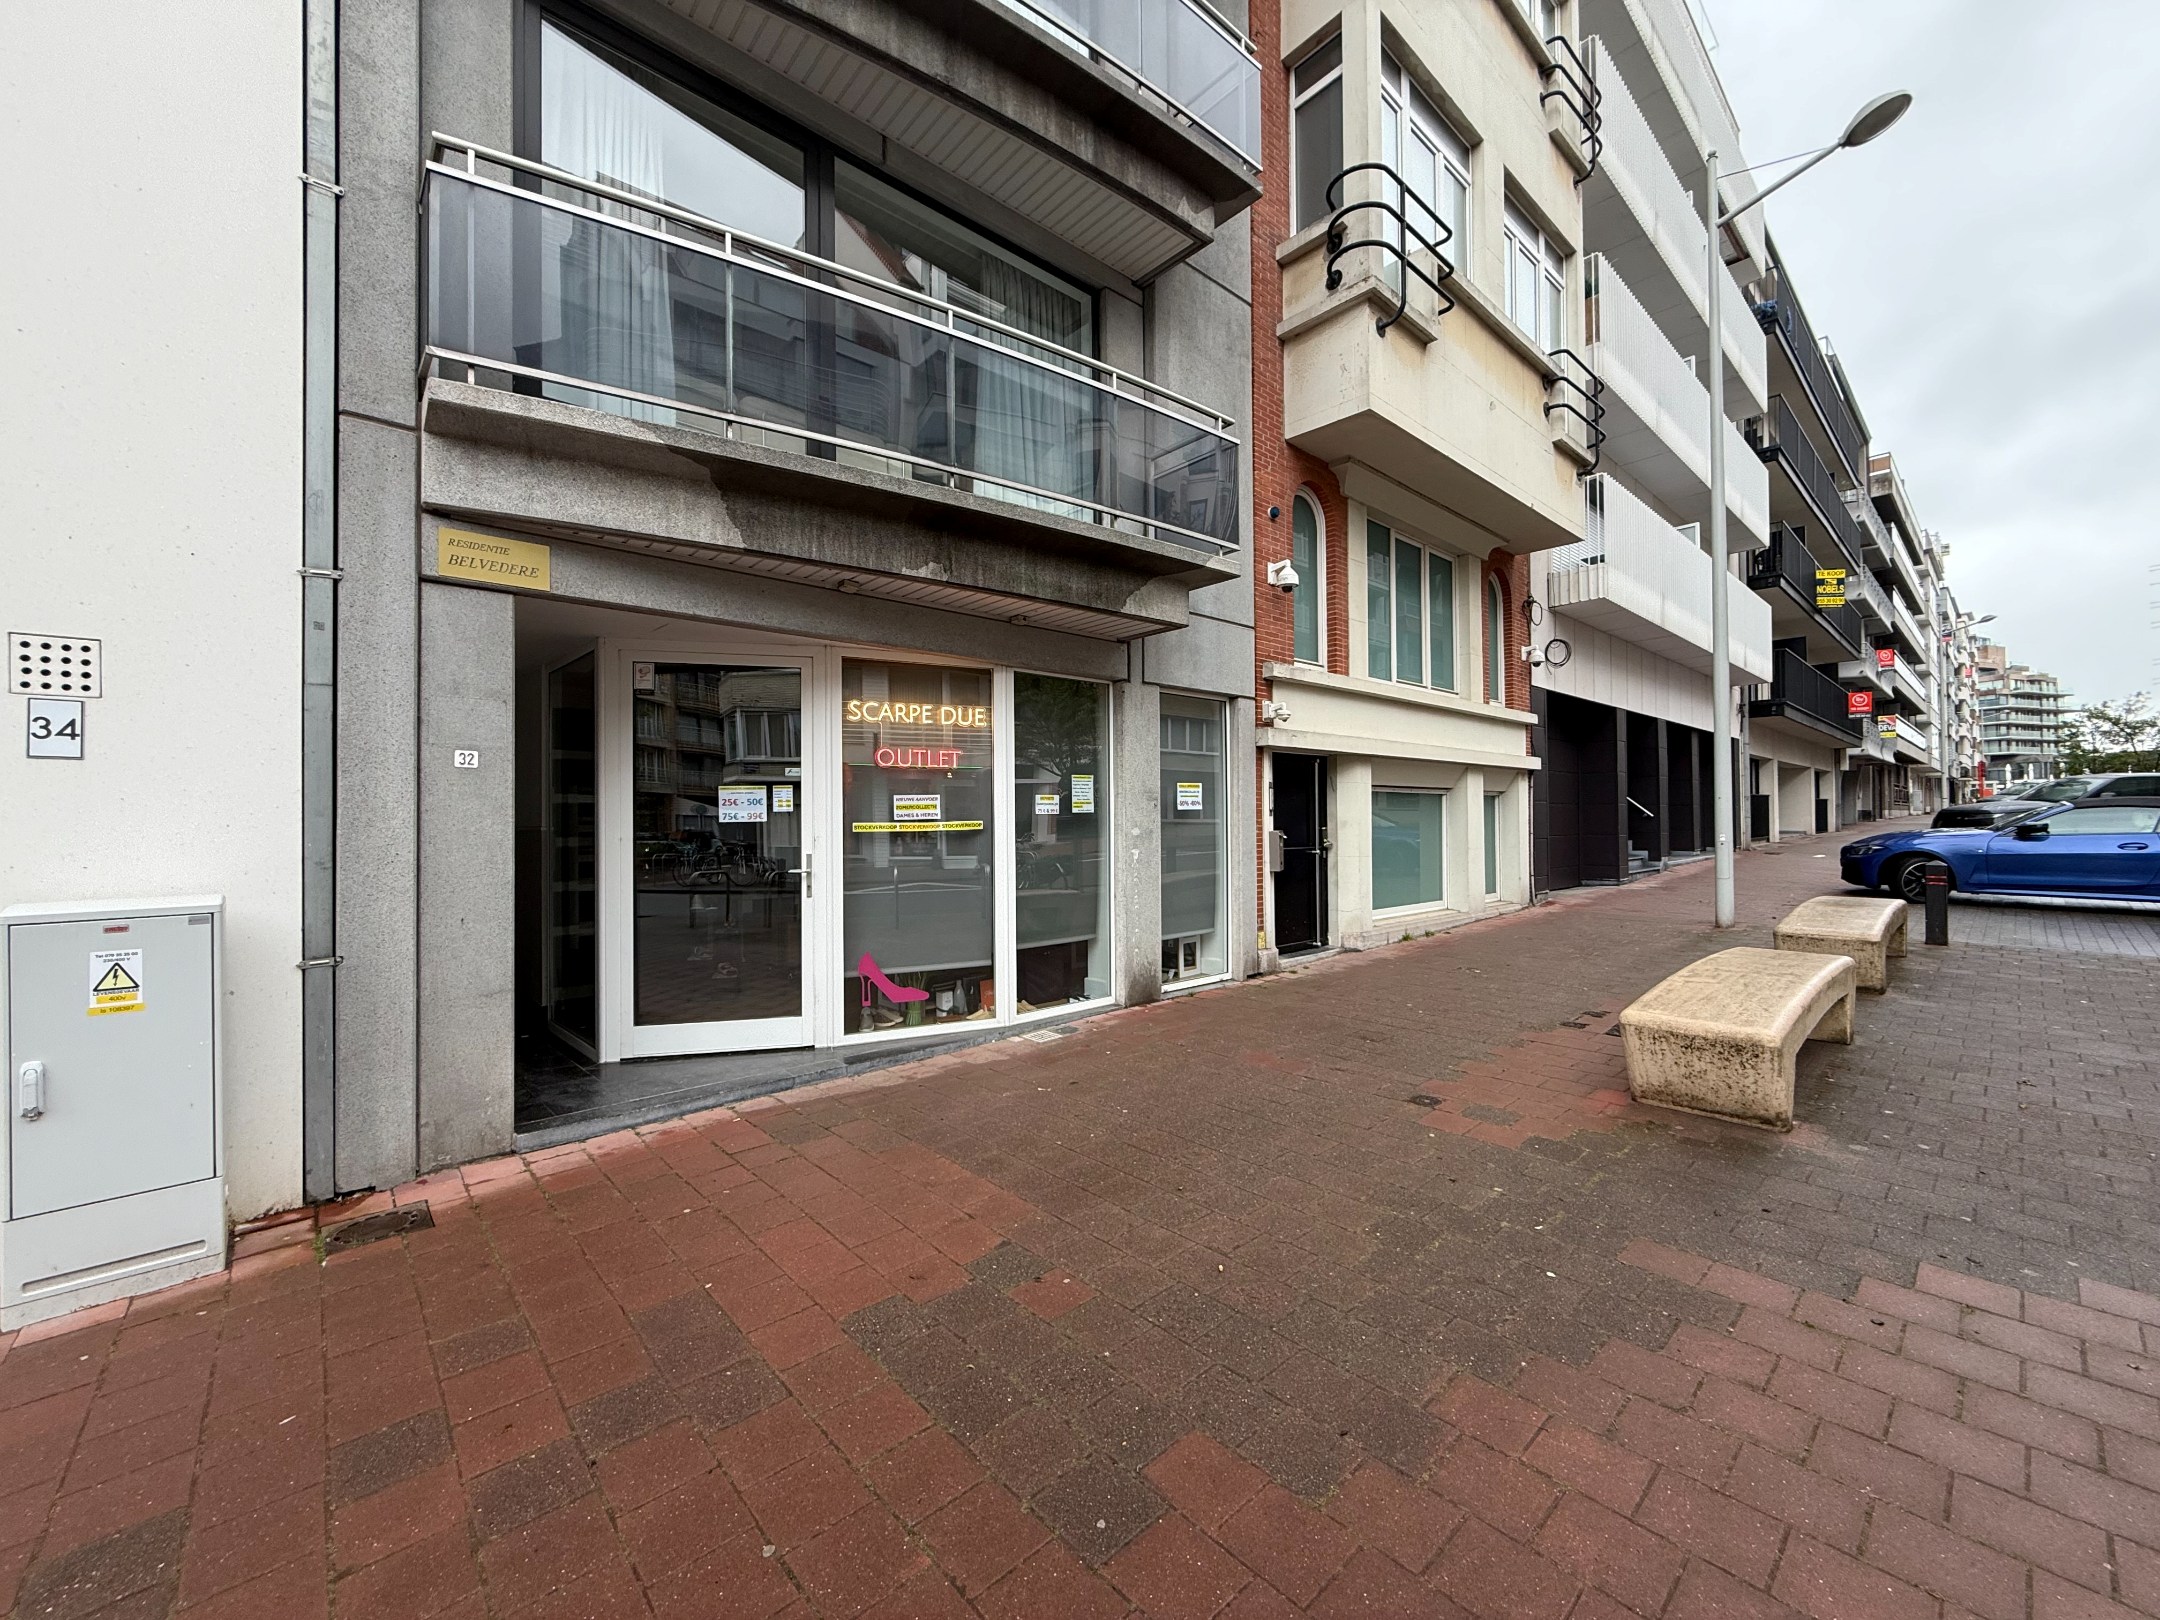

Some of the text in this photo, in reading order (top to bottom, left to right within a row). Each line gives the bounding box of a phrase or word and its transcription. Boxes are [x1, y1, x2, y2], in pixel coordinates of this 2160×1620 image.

[447, 537, 511, 556] RESIDENTIE
[447, 553, 540, 579] BELVEDERE
[1816, 584, 1845, 594] NOBELS
[847, 699, 987, 728] SCARPE DUE
[30, 715, 81, 741] 34
[458, 752, 475, 766] 32
[875, 747, 962, 769] OUTLET
[721, 798, 739, 807] 25€
[746, 797, 764, 806] 50€
[721, 812, 739, 821] 75€
[746, 812, 764, 820] 99€
